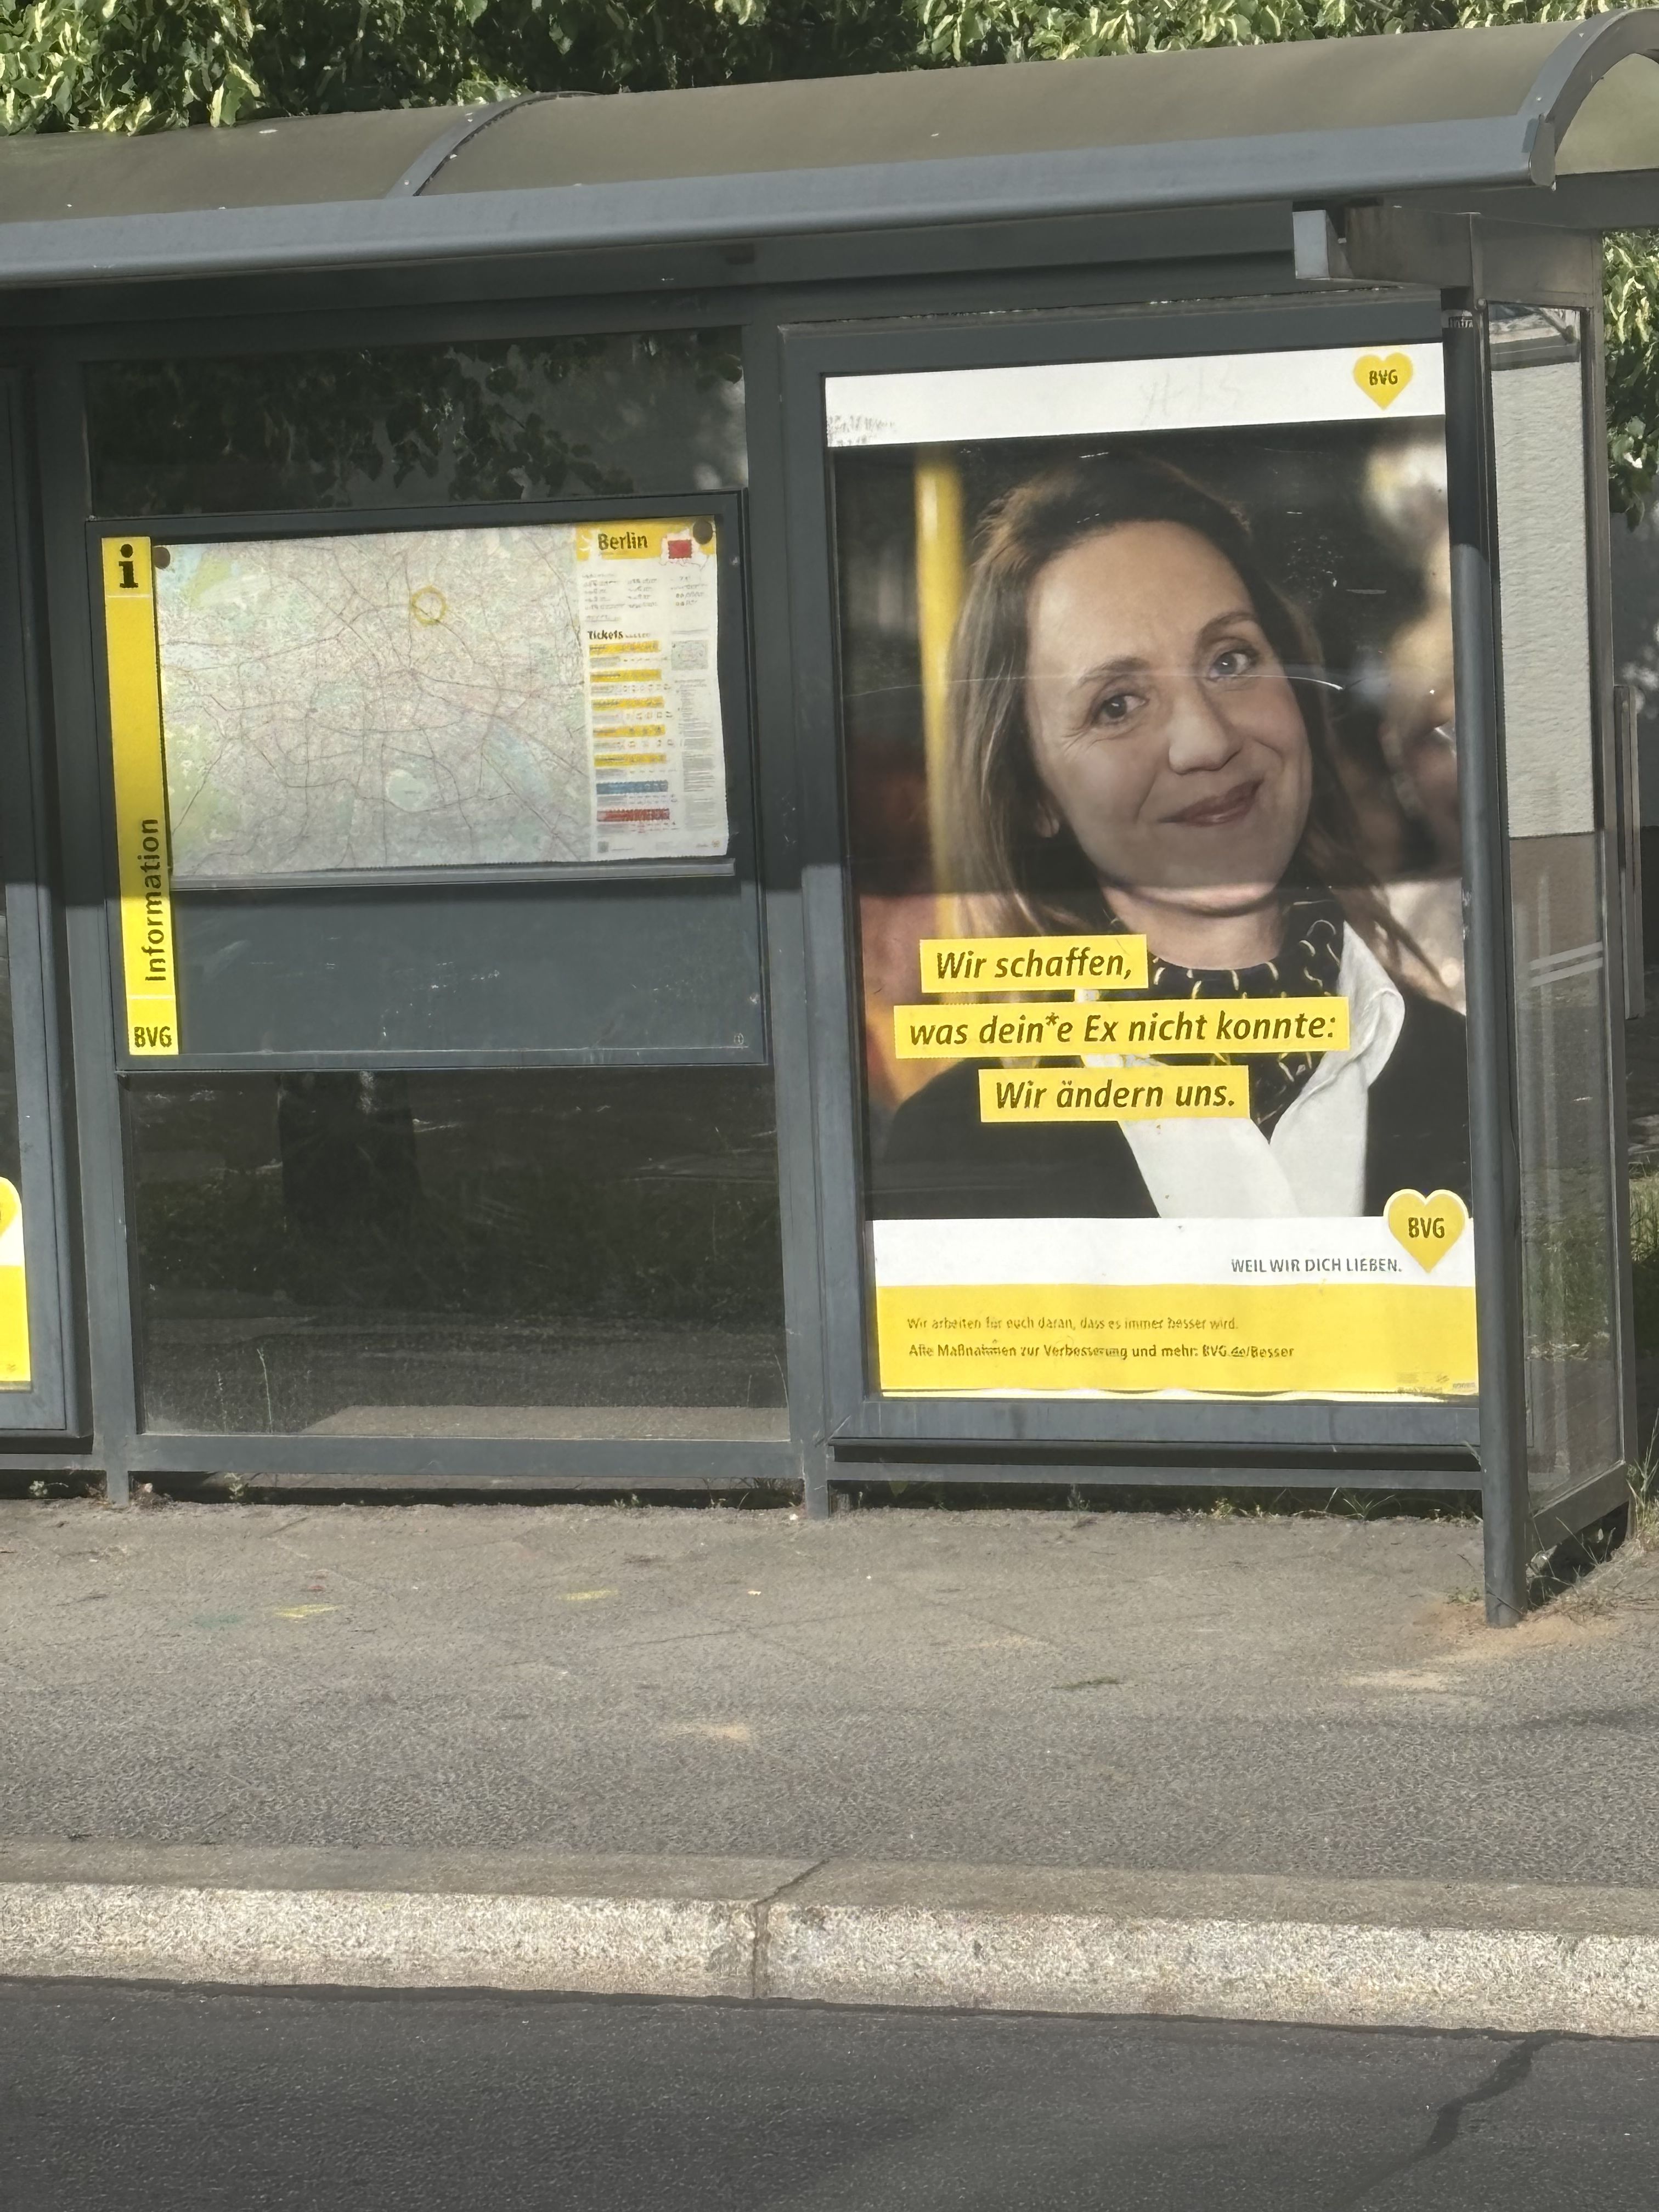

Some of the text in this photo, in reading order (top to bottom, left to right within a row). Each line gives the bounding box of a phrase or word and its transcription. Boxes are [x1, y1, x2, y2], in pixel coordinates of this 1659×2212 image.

[1369, 369, 1398, 386] BVG
[597, 531, 648, 550] Berlin
[588, 630, 624, 640] Tickets
[137, 818, 167, 982] Information
[937, 946, 1132, 980] Wir schaffen,
[133, 1026, 173, 1048] BVG
[910, 1024, 969, 1045] was
[1084, 1015, 1118, 1042] Ex
[1128, 1011, 1208, 1041] nicht
[1215, 1011, 1336, 1040] konnte:
[996, 1079, 1235, 1109] Wir ändern uns.
[1408, 1217, 1446, 1239] BVG
[1231, 1257, 1403, 1273] WEIL WIR DICH LIEBEN.
[907, 1317, 927, 1329] Wir
[932, 1316, 981, 1329] arbeiten
[1006, 1316, 1035, 1329] euch
[1038, 1315, 1076, 1331] daran,
[1080, 1316, 1105, 1329] dass
[1108, 1318, 1122, 1329] es
[1125, 1317, 1164, 1329] immer
[1167, 1317, 1206, 1329] besser
[1020, 1344, 1040, 1357] zur
[1044, 1342, 1128, 1360] Verbesserung
[1132, 1344, 1156, 1357] und
